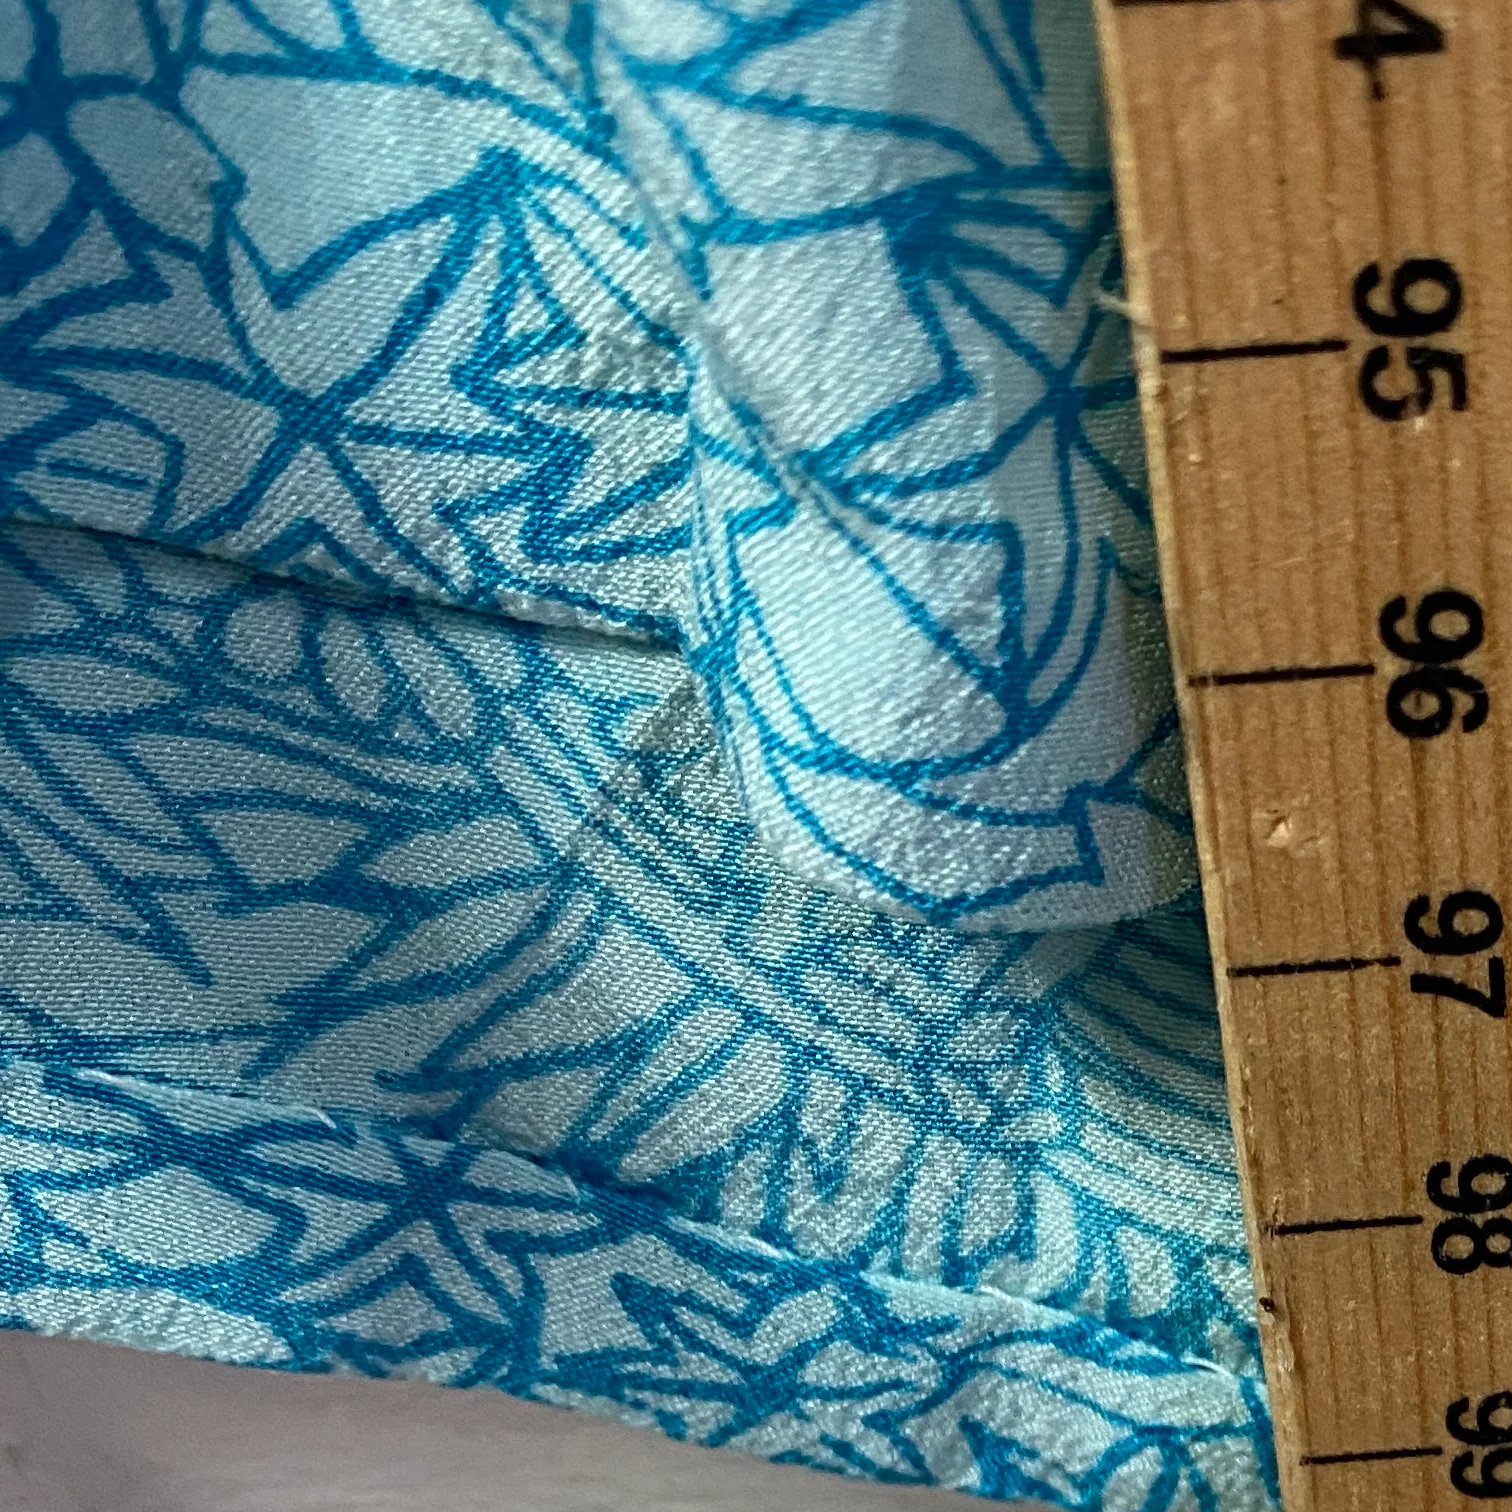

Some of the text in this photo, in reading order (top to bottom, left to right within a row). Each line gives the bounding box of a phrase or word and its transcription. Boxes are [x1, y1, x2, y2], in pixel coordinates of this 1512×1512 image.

[1349, 257, 1469, 423] 95
[1377, 586, 1491, 740] 96
[1402, 888, 1508, 1020] 97
